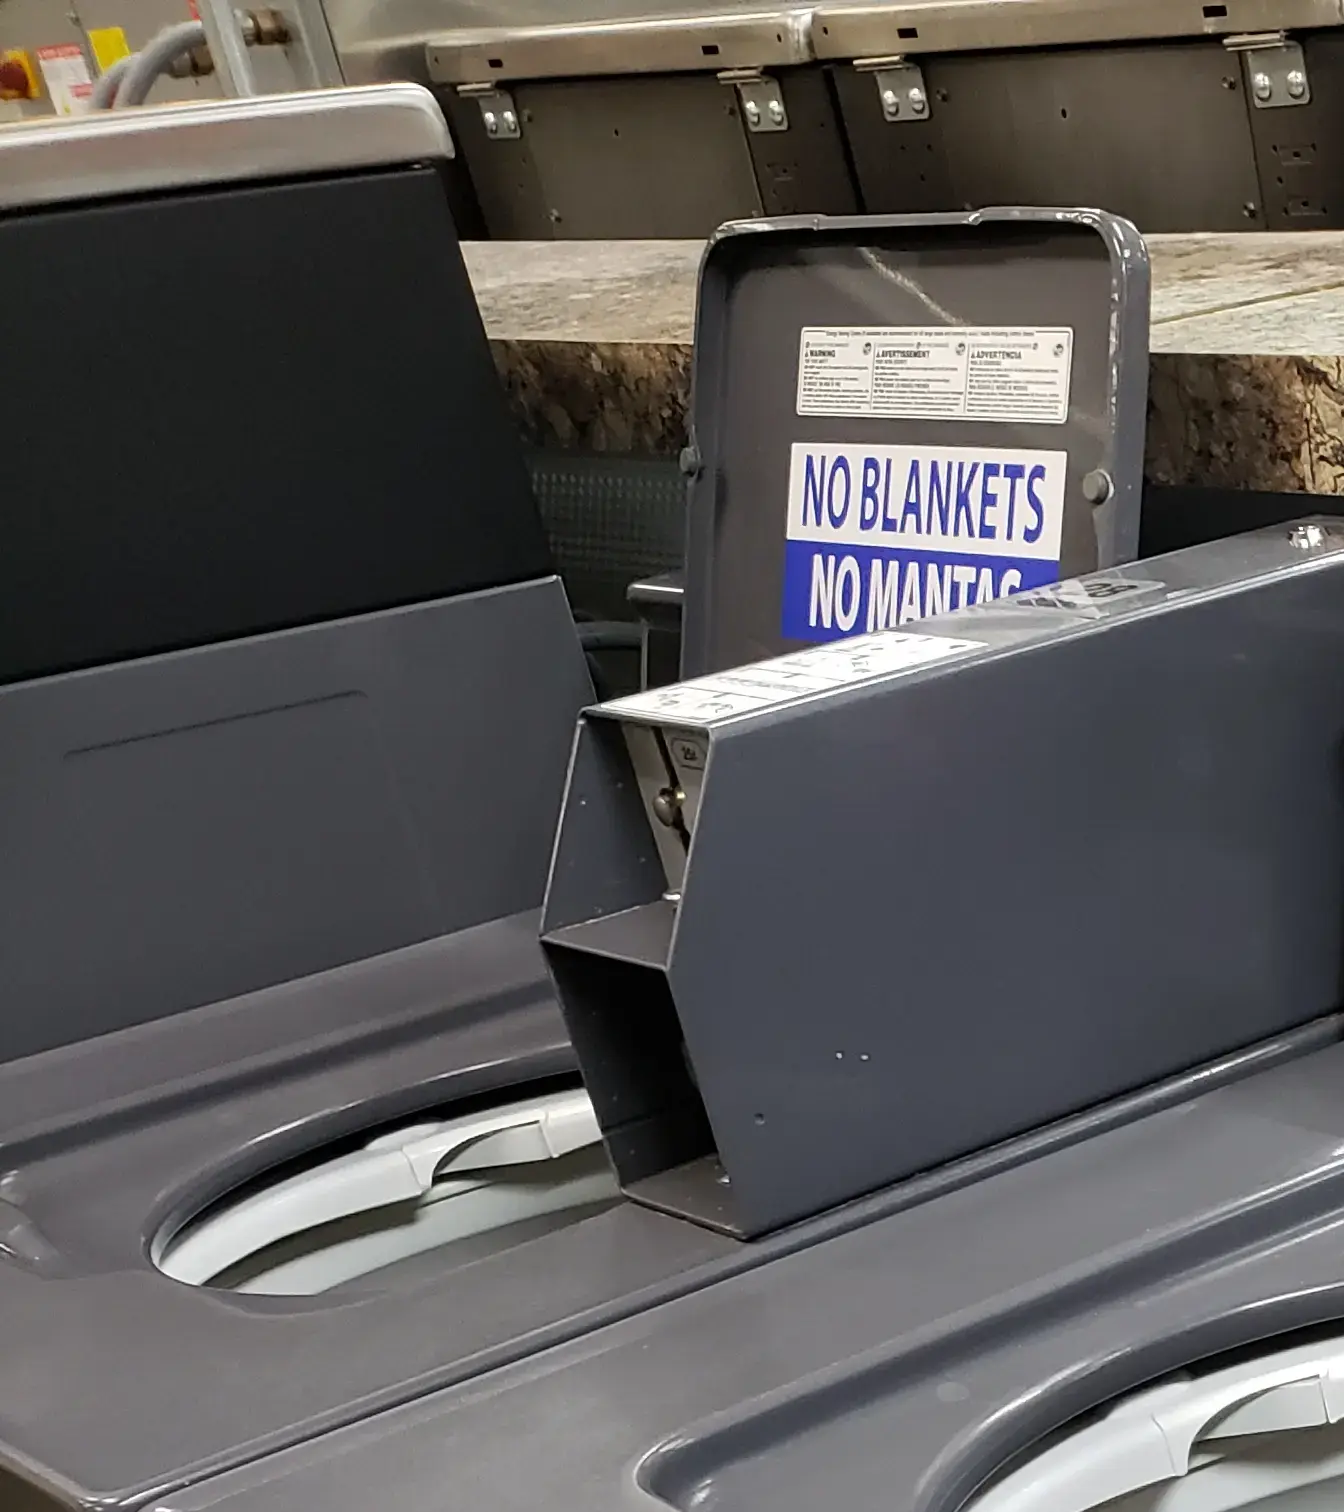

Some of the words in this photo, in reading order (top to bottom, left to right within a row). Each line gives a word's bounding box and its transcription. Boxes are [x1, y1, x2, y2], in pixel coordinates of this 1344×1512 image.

[802, 455, 851, 528] NO
[860, 458, 1046, 544] BLANKETS
[809, 555, 860, 631] NO
